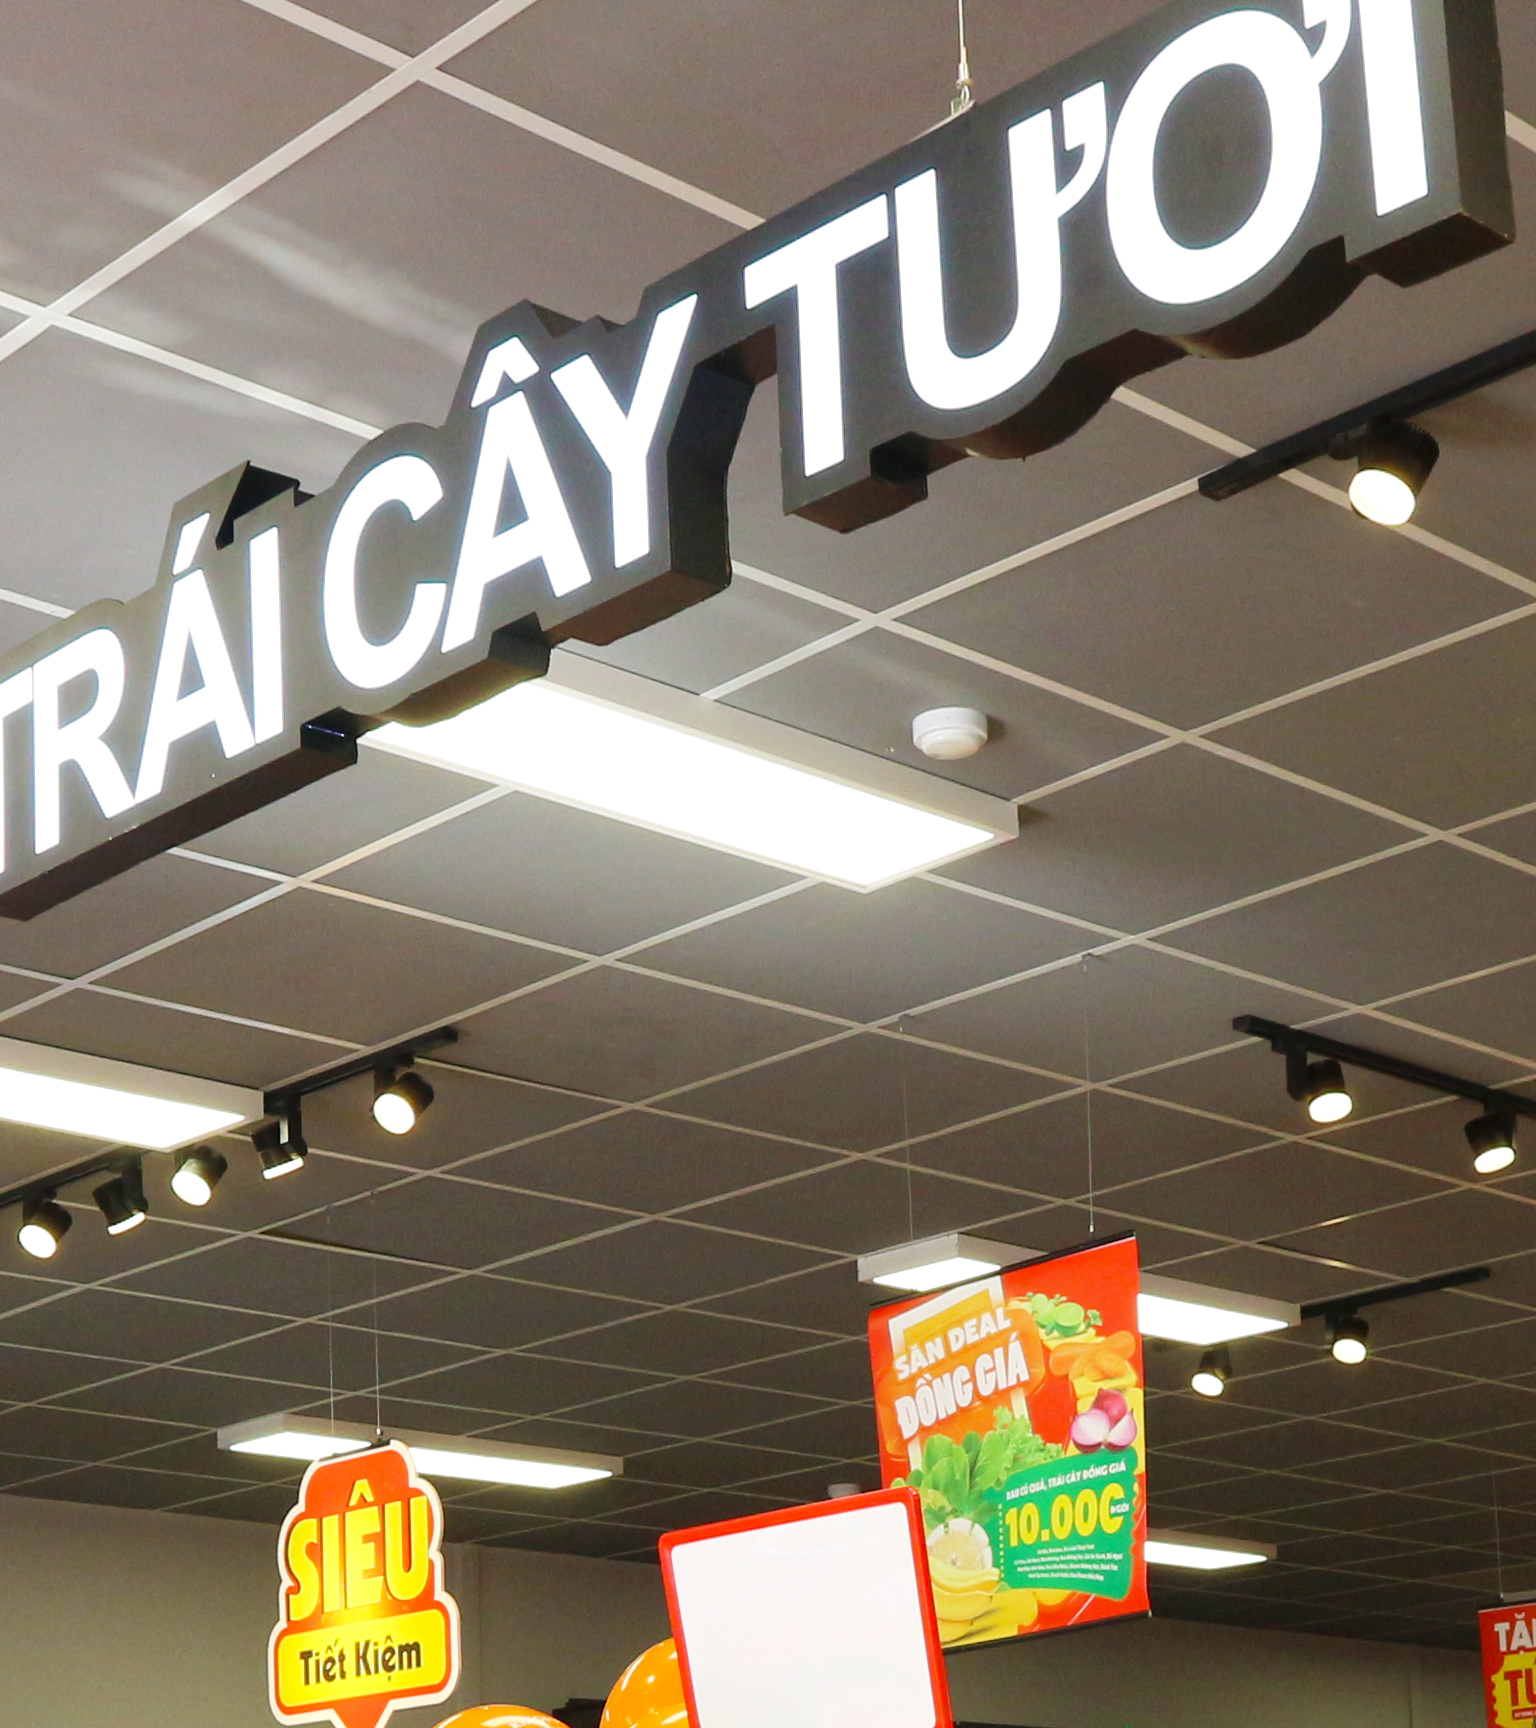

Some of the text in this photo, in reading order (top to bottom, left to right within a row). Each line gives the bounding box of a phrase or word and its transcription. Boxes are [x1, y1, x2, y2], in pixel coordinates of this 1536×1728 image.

[322, 294, 698, 689] CÂY
[744, 0, 1429, 477] TƯƠI
[894, 1306, 1012, 1380] SĂN DEAL
[894, 1334, 1030, 1440] ĐỒNG GIÁ
[288, 1478, 429, 1621] SIÊU
[300, 1636, 422, 1686] Tiết Kiệm
